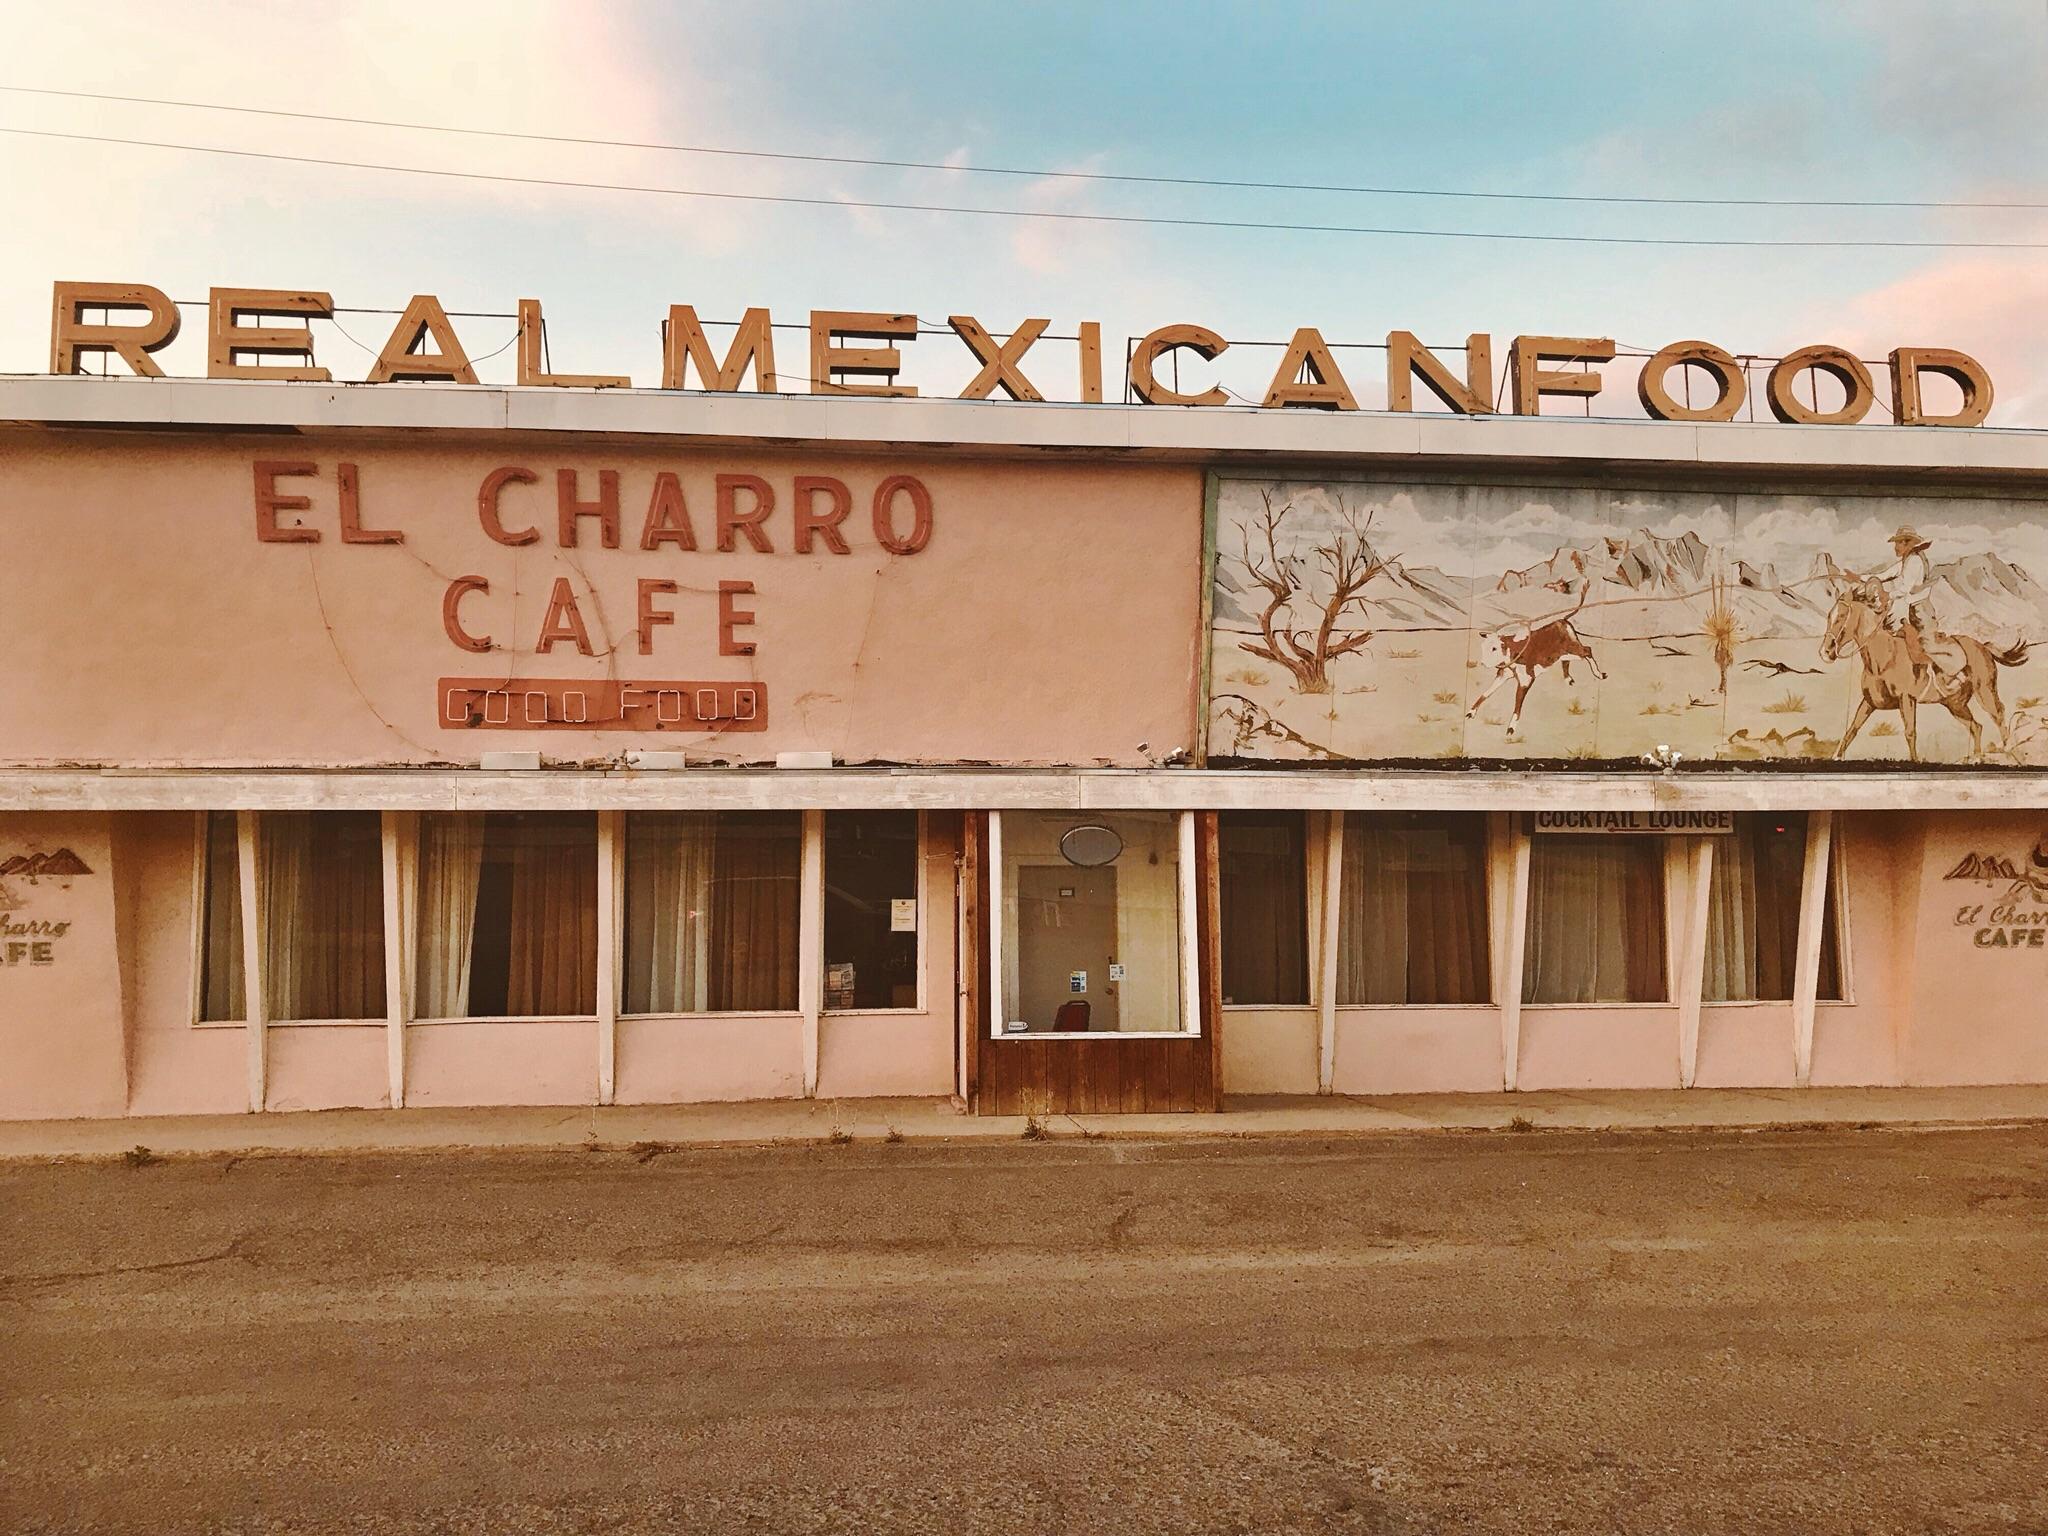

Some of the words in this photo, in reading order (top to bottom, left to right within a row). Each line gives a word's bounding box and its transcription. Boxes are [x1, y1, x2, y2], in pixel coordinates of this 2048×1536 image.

[50, 281, 631, 387] REAL
[661, 304, 1493, 415] MEXICAN
[1511, 335, 1995, 427] FOOD
[253, 461, 404, 544] EL
[478, 466, 933, 555] CHARRO
[443, 574, 757, 656] CAFE
[621, 689, 756, 721] FOOD
[1538, 811, 1640, 828] COCKTAIL
[1649, 811, 1730, 829] LOUNGE
[0, 913, 71, 938] harro
[1955, 905, 1984, 925] El
[1989, 905, 2048, 926] Char
[1974, 928, 2045, 948] CAFE
[0, 941, 54, 965] FE
